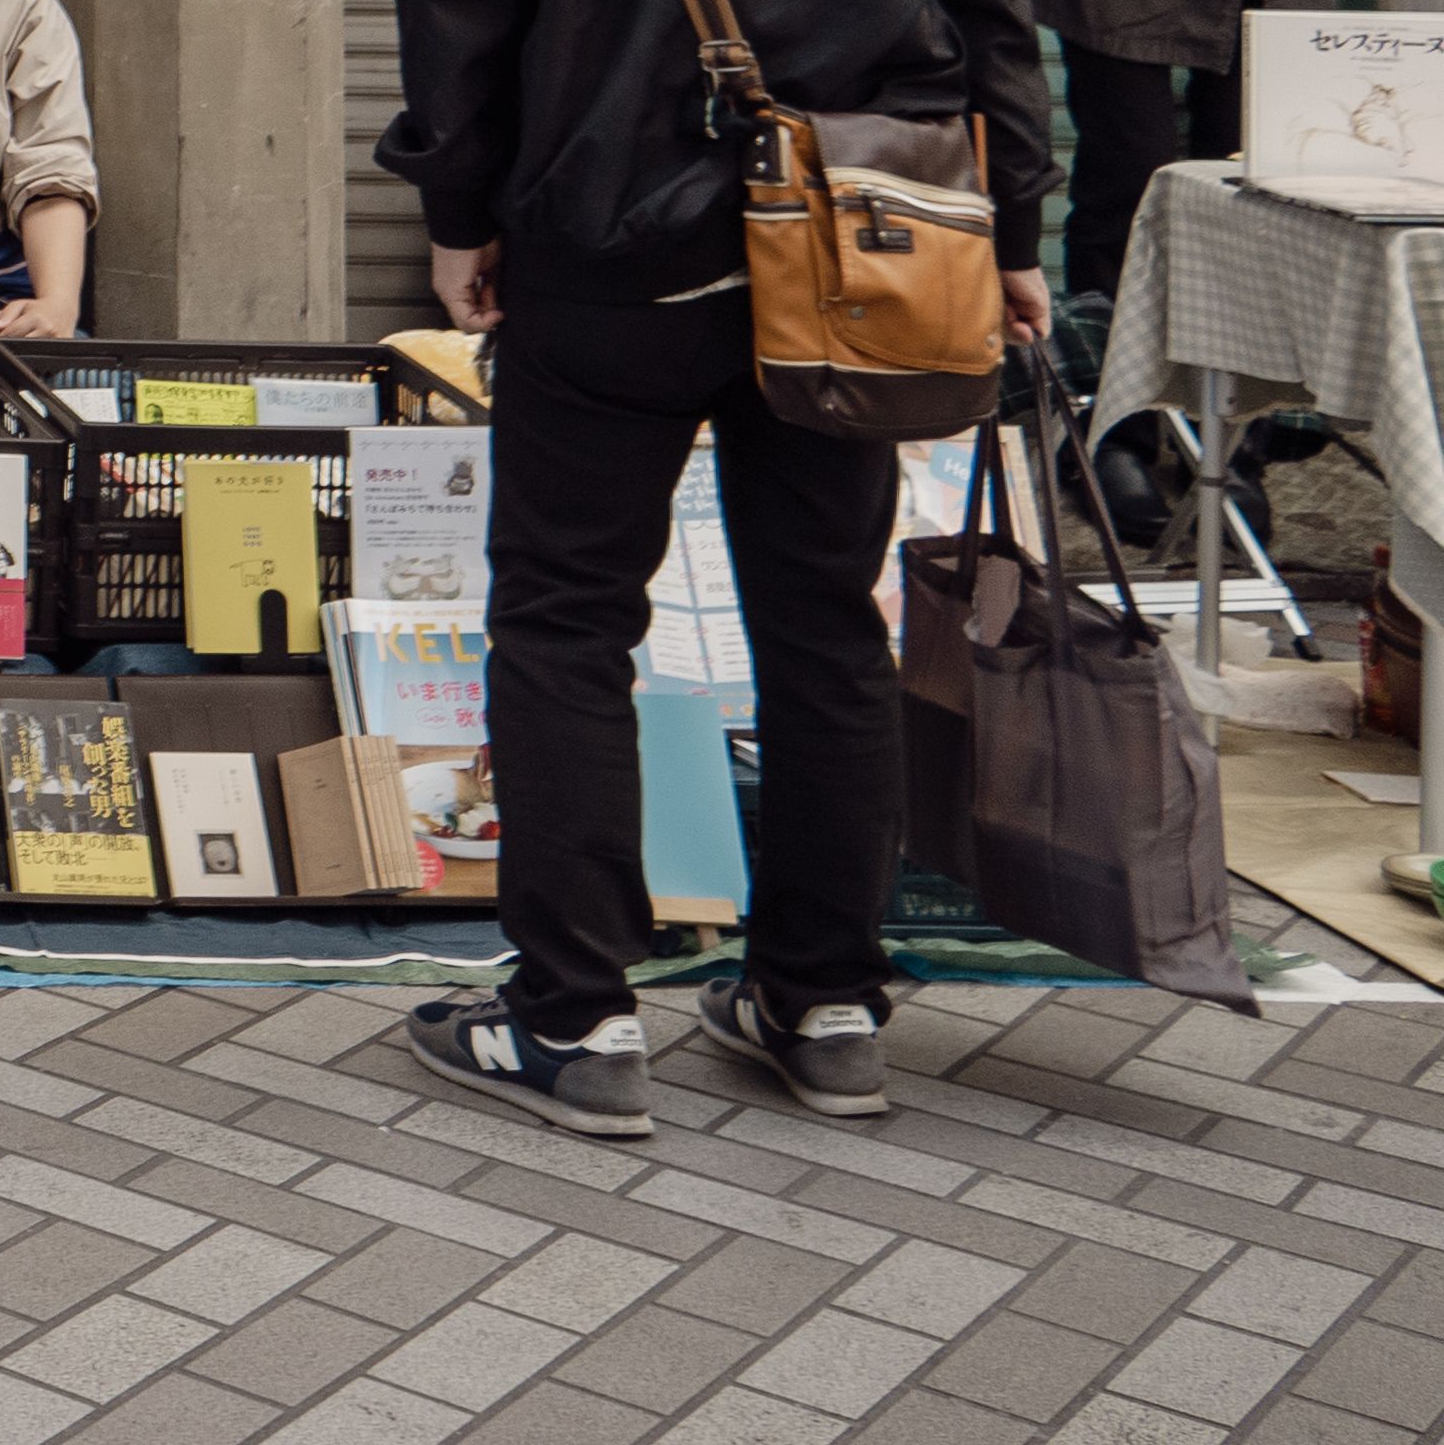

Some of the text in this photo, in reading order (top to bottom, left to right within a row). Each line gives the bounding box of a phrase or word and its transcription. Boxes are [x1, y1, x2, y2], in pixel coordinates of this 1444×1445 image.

[81, 741, 113, 818] 創った男
[102, 716, 137, 829] 娯楽番組を
